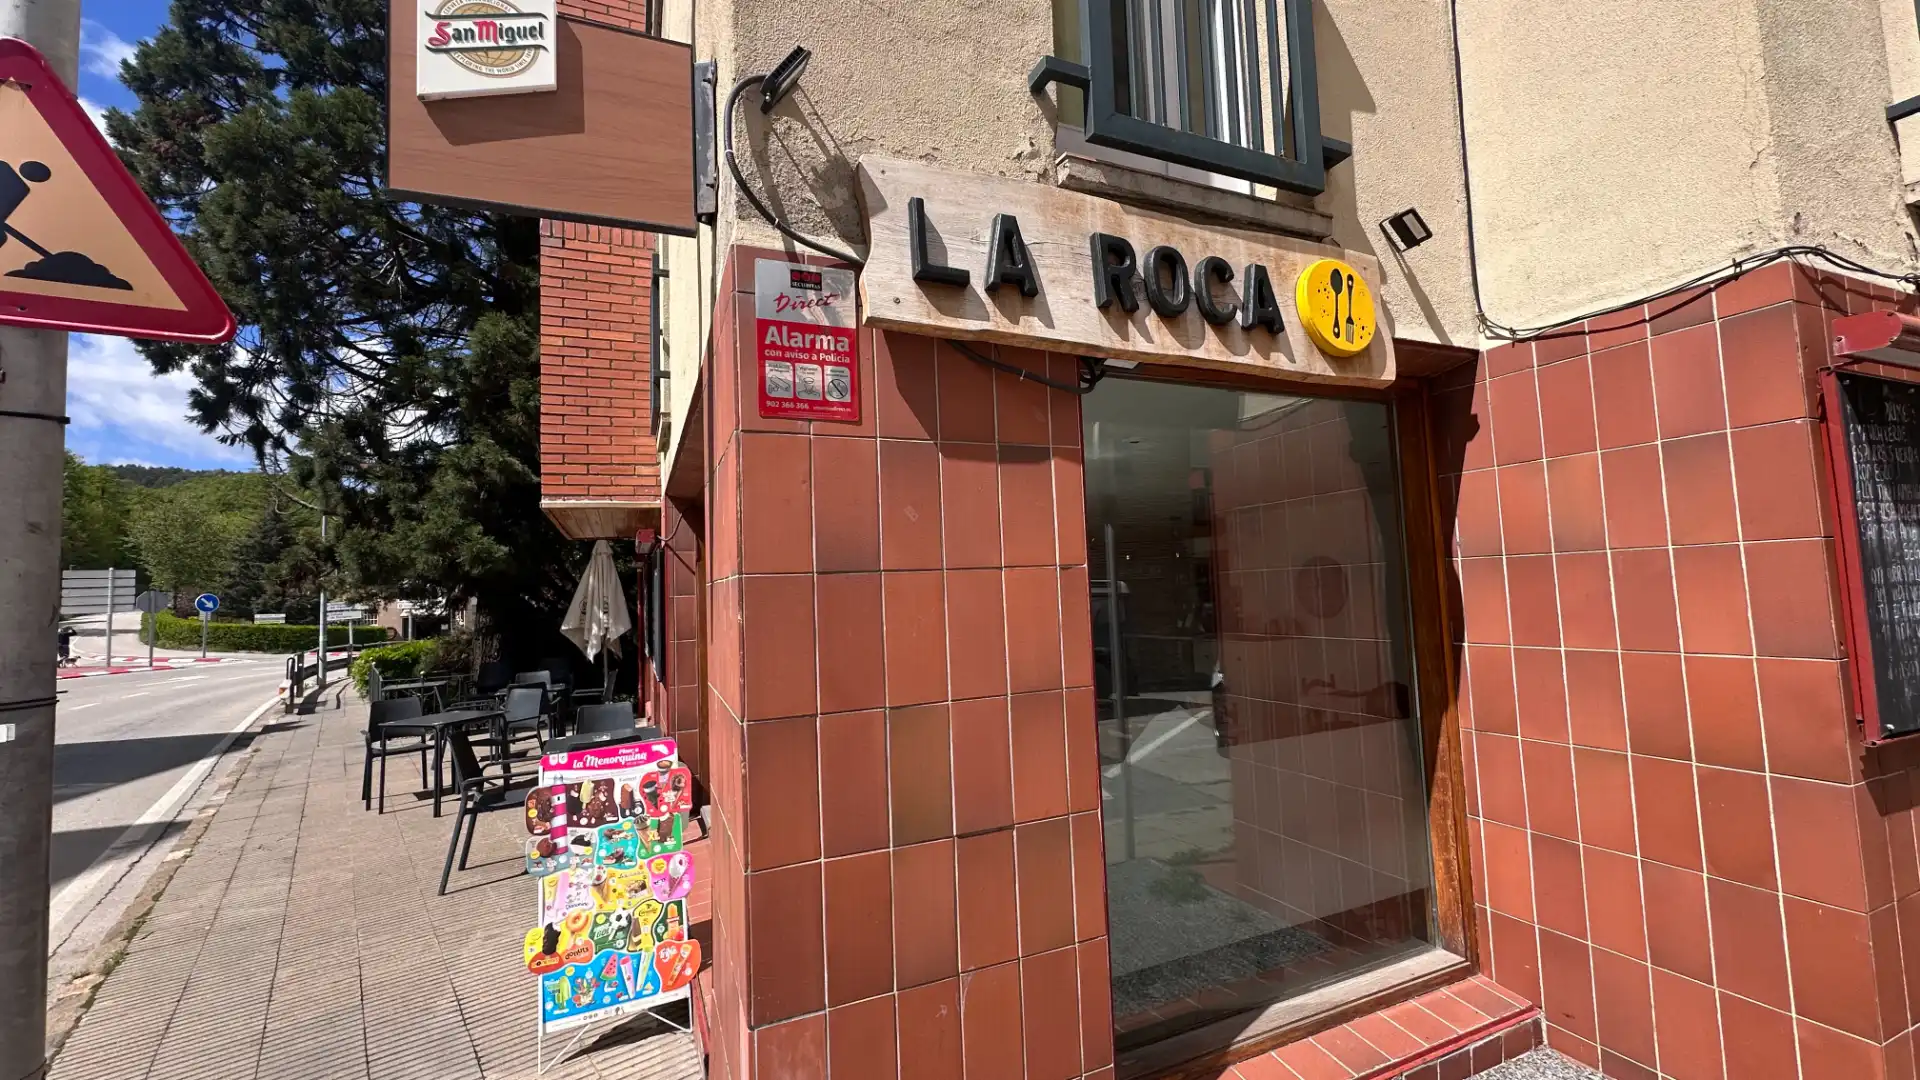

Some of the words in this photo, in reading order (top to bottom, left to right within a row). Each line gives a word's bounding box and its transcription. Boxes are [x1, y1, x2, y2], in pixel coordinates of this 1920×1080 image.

[908, 196, 1041, 299] LA
[1090, 231, 1285, 335] ROCA
[773, 292, 838, 314] Direct
[764, 325, 850, 352] Alarma
[764, 348, 782, 357] con
[784, 349, 809, 360] aviso
[811, 353, 818, 361] a
[765, 400, 779, 408] 902
[573, 759, 584, 769] la
[584, 751, 648, 768] Menorquina
[565, 946, 589, 960] donuts
